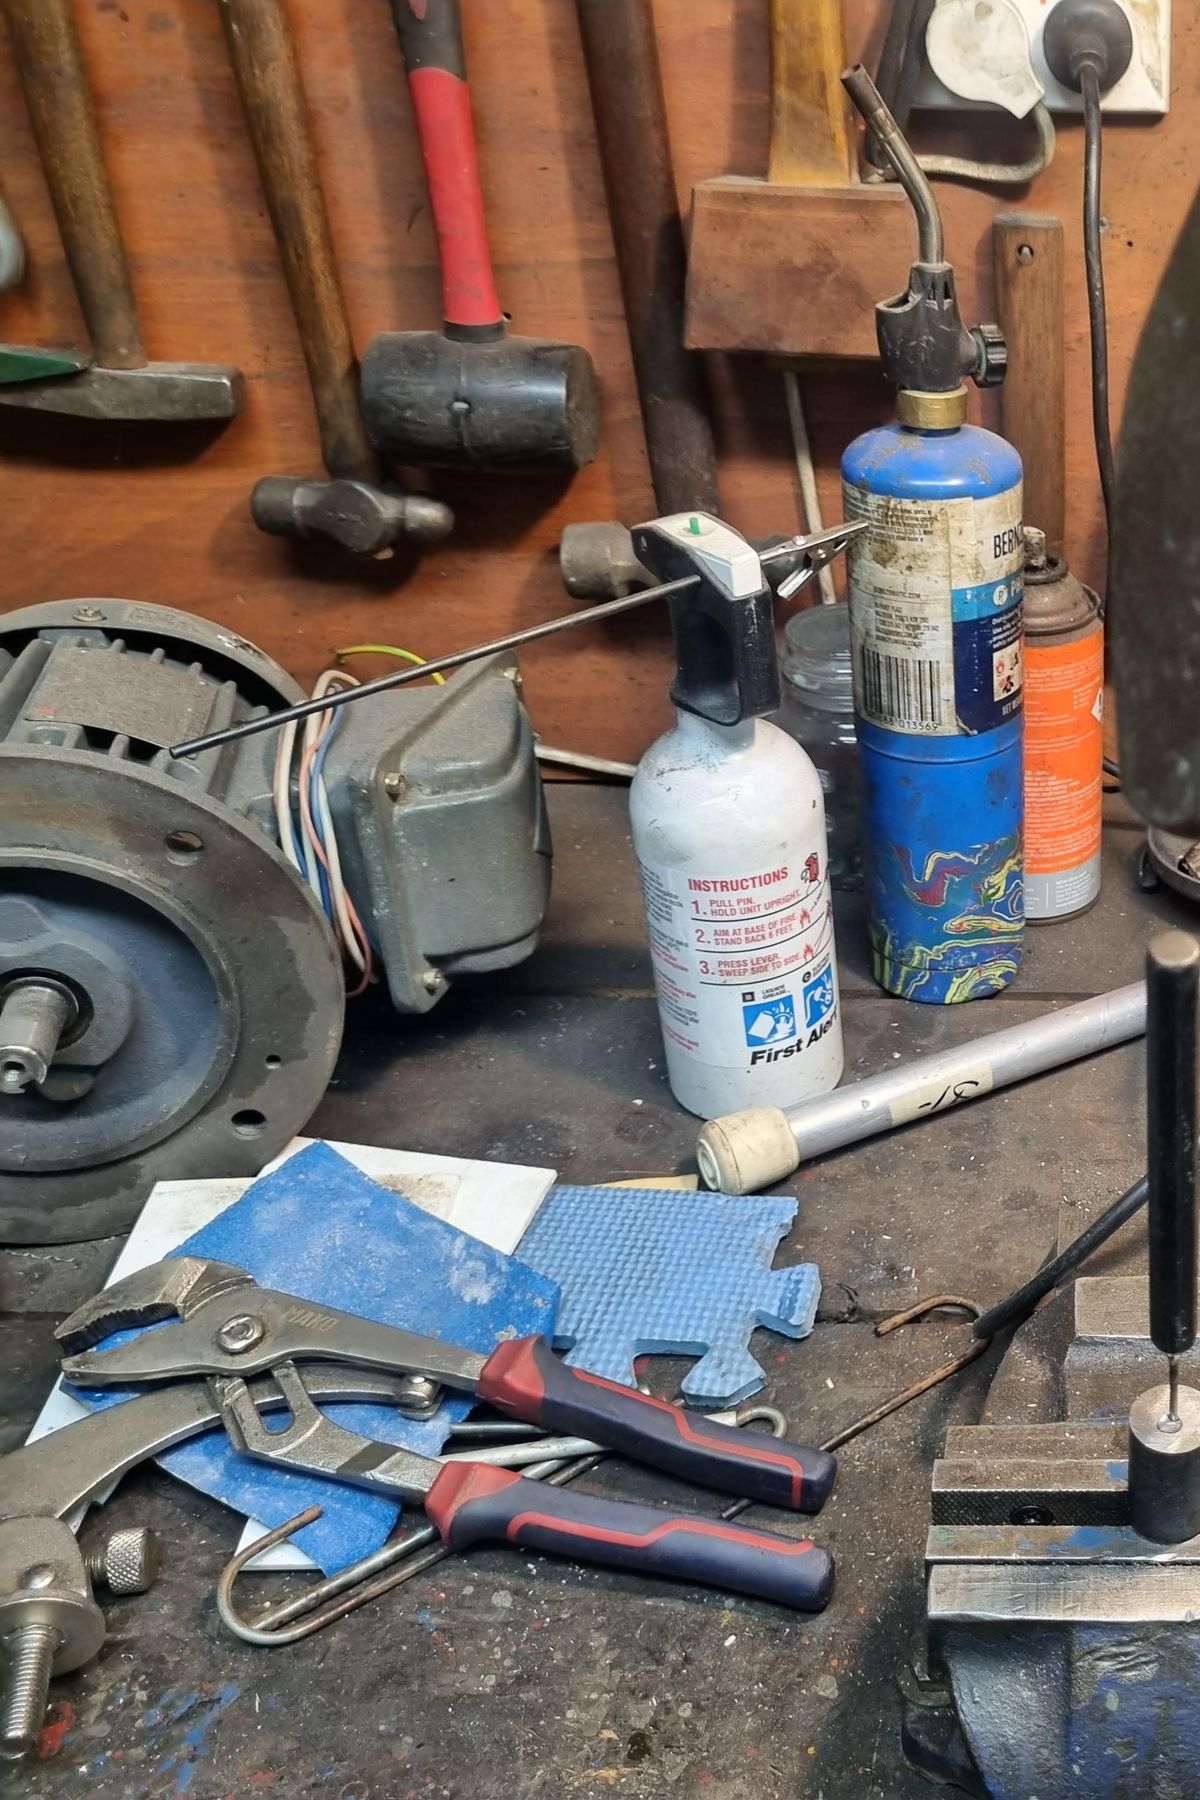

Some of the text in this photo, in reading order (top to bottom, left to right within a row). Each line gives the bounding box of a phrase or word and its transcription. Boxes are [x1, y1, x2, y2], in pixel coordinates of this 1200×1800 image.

[688, 867, 788, 892] INSTRUCTIONS
[691, 900, 707, 915] 1.
[709, 899, 733, 908] PULL
[710, 908, 737, 917] HOLD
[740, 904, 761, 915] UNIT
[695, 929, 711, 944] 2.
[713, 929, 730, 937] AIM
[732, 928, 742, 936] AT
[744, 924, 766, 935] BASE
[768, 920, 778, 930] OF
[714, 937, 742, 946] STAND
[745, 934, 766, 944] BACK
[768, 931, 774, 939] 6
[699, 960, 715, 975] 3.
[718, 959, 748, 969] PRESS
[718, 968, 748, 977] SWEEP
[751, 964, 770, 975] SIDE
[772, 961, 782, 970] TO
[750, 1038, 803, 1065] First
